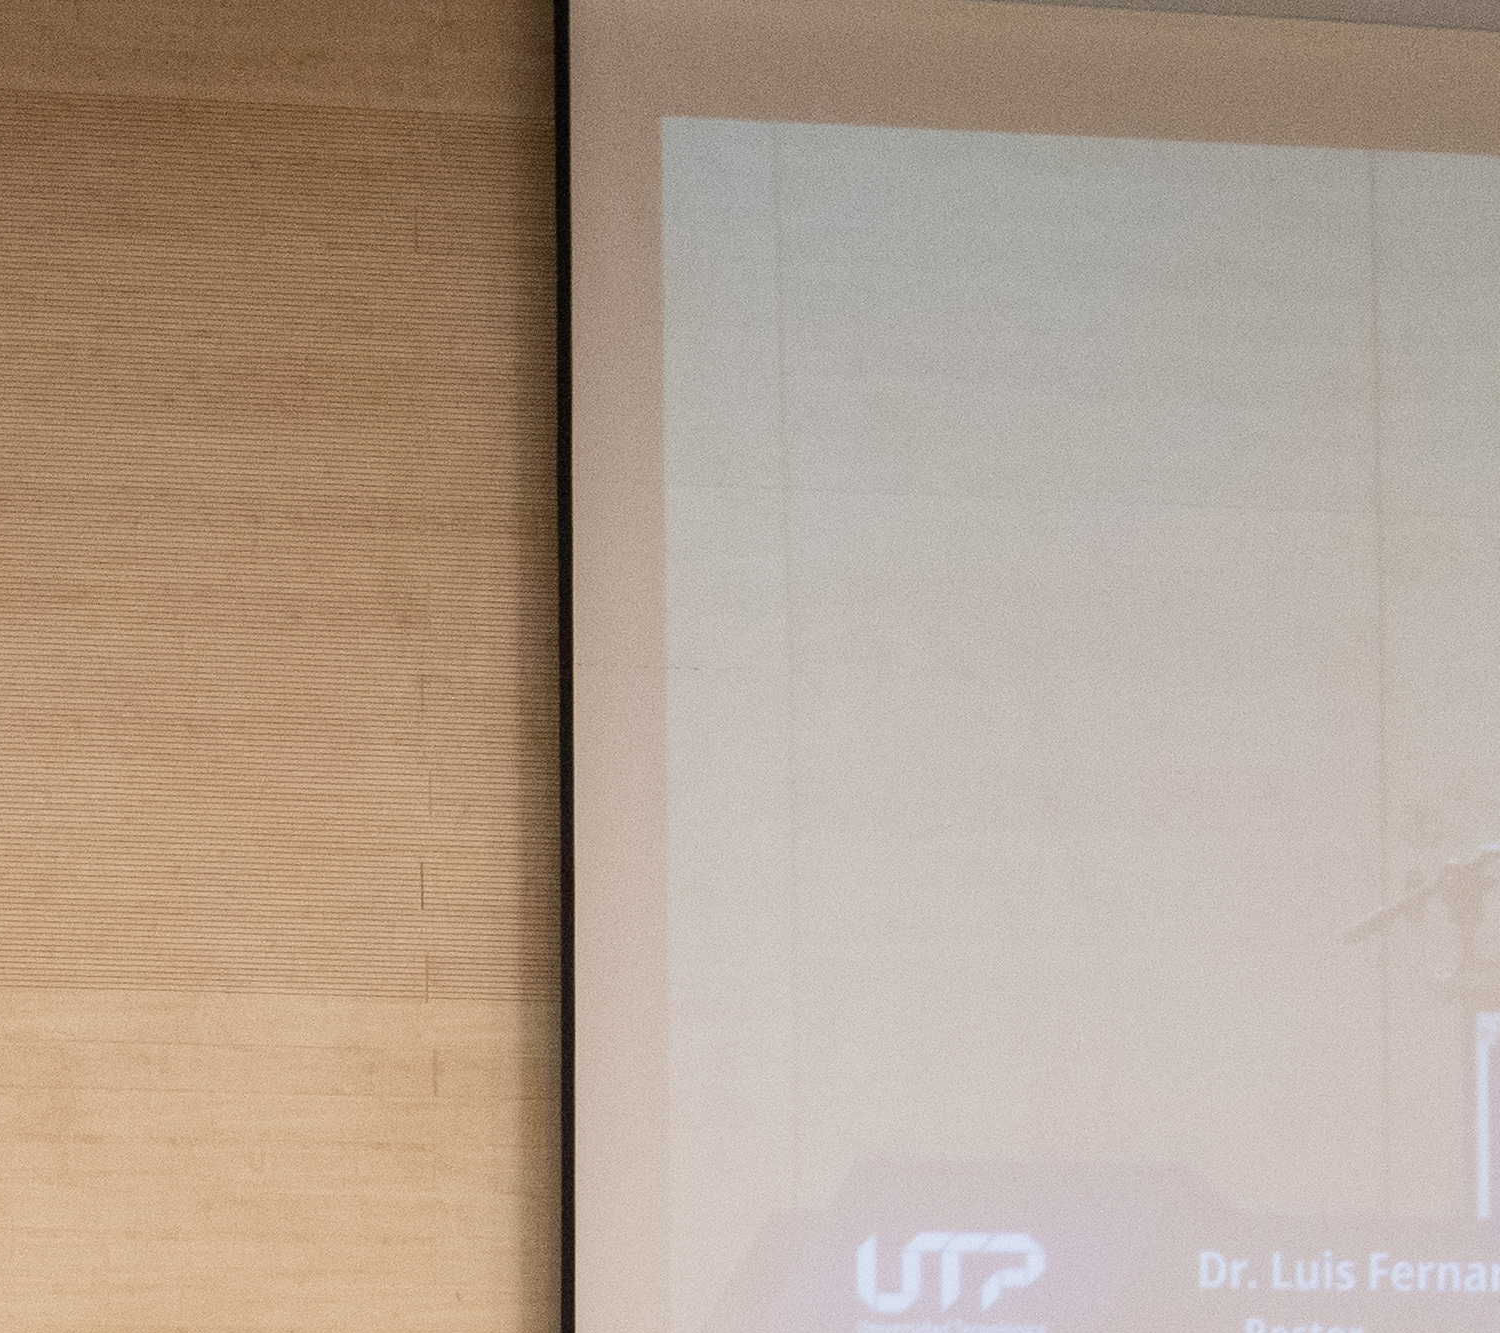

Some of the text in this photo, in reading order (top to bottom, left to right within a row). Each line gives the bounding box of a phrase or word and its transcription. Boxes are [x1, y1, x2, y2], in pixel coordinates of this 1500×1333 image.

[856, 1230, 1047, 1316] UTP
[1199, 1250, 1257, 1290] Dr.
[1271, 1250, 1356, 1291] Luis
